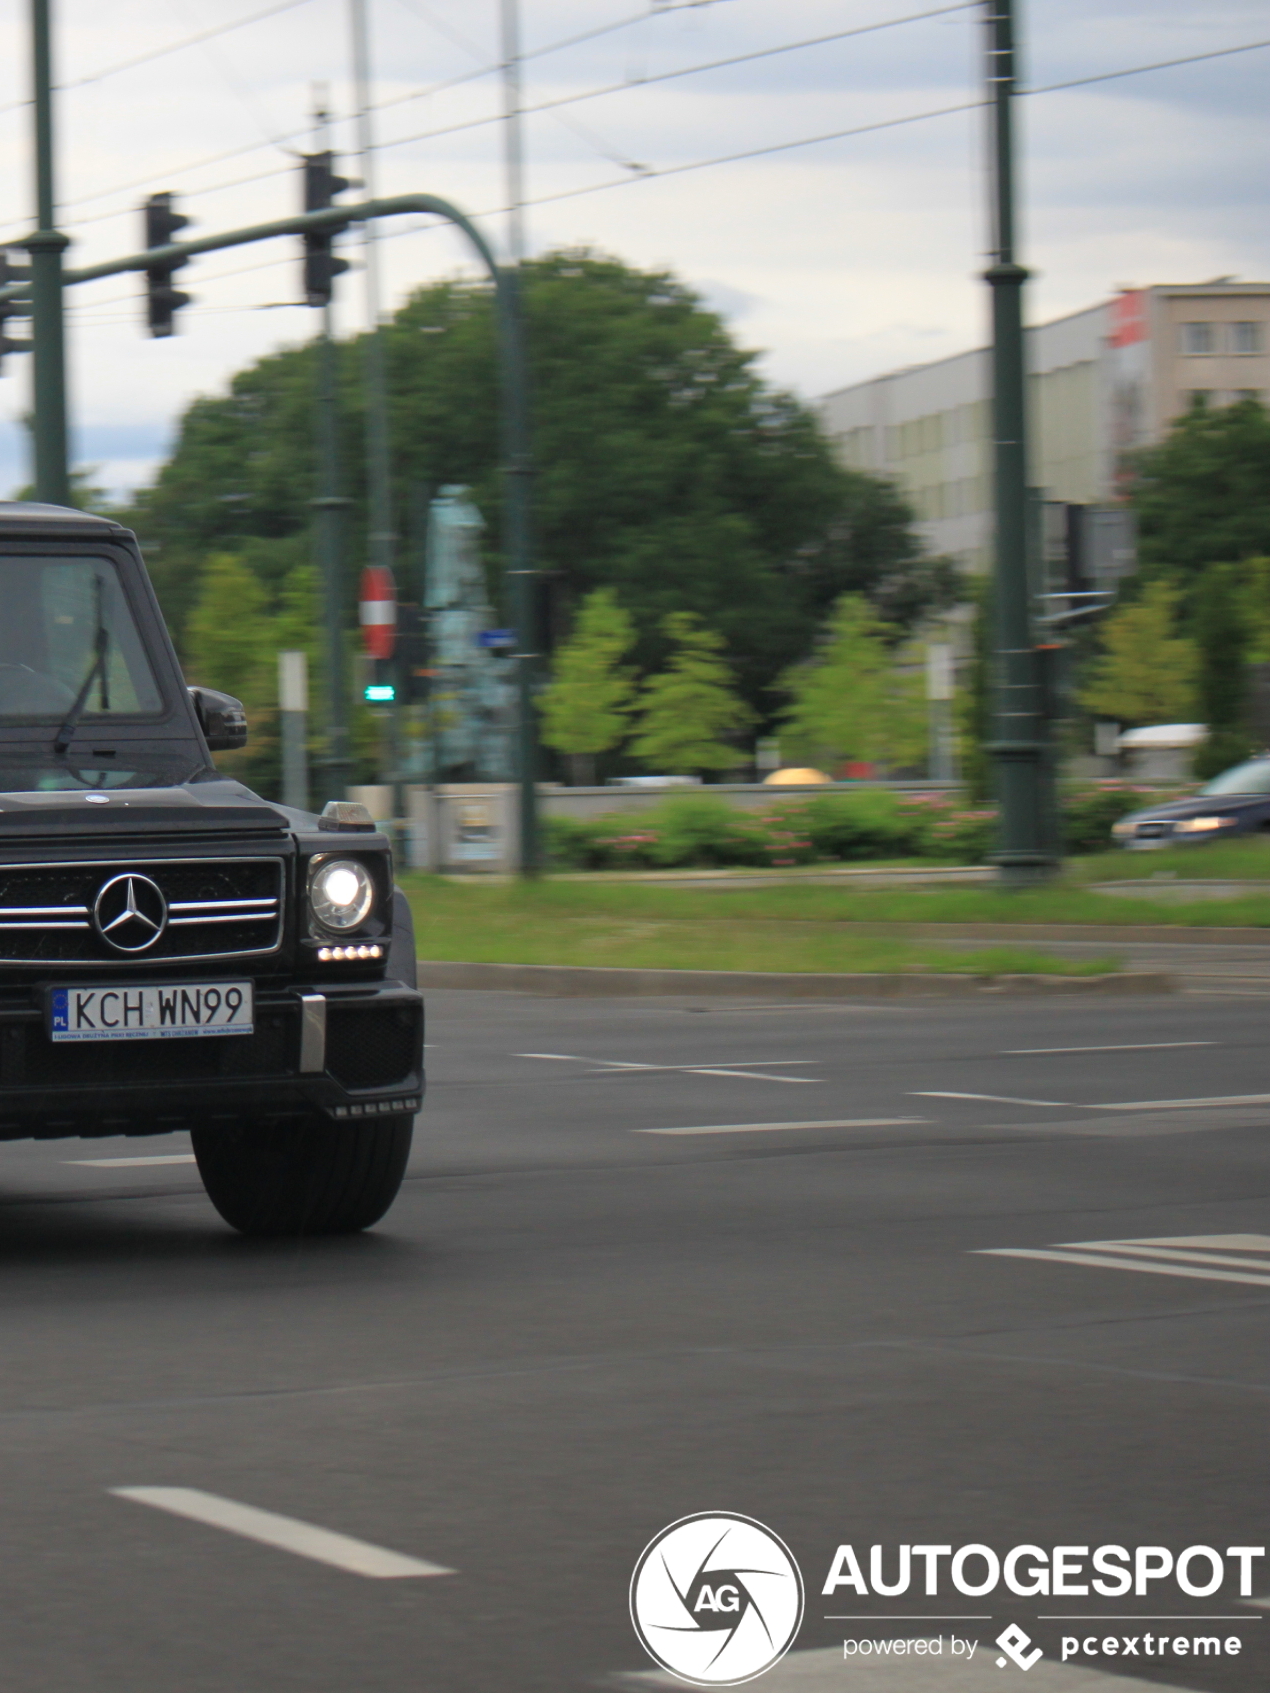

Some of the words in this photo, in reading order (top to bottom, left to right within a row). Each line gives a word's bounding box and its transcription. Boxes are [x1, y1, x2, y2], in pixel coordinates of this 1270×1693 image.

[76, 990, 144, 1029] KCH
[158, 987, 244, 1026] WN99
[53, 1016, 67, 1027] PL
